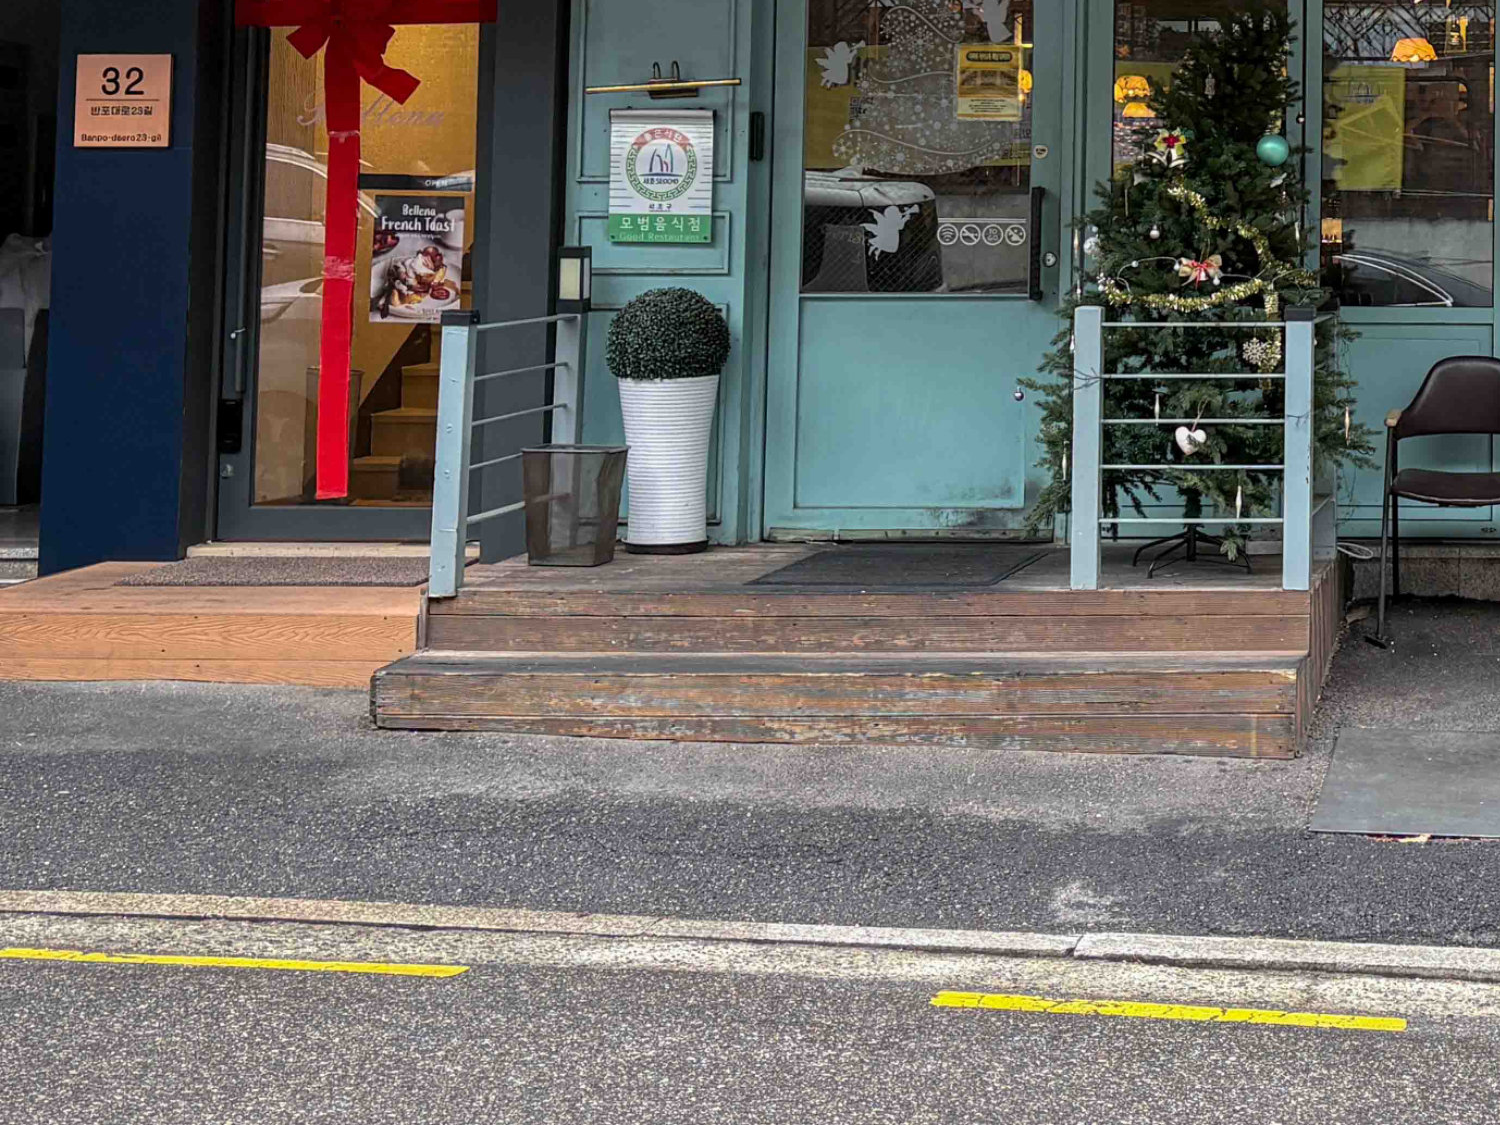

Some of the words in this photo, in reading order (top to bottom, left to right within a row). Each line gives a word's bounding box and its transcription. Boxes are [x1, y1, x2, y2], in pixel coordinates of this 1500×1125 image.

[101, 67, 144, 95] 32
[402, 203, 436, 217] Bellena
[381, 216, 421, 232] French
[425, 217, 456, 233] Toast
[619, 216, 700, 232] 모범음식점
